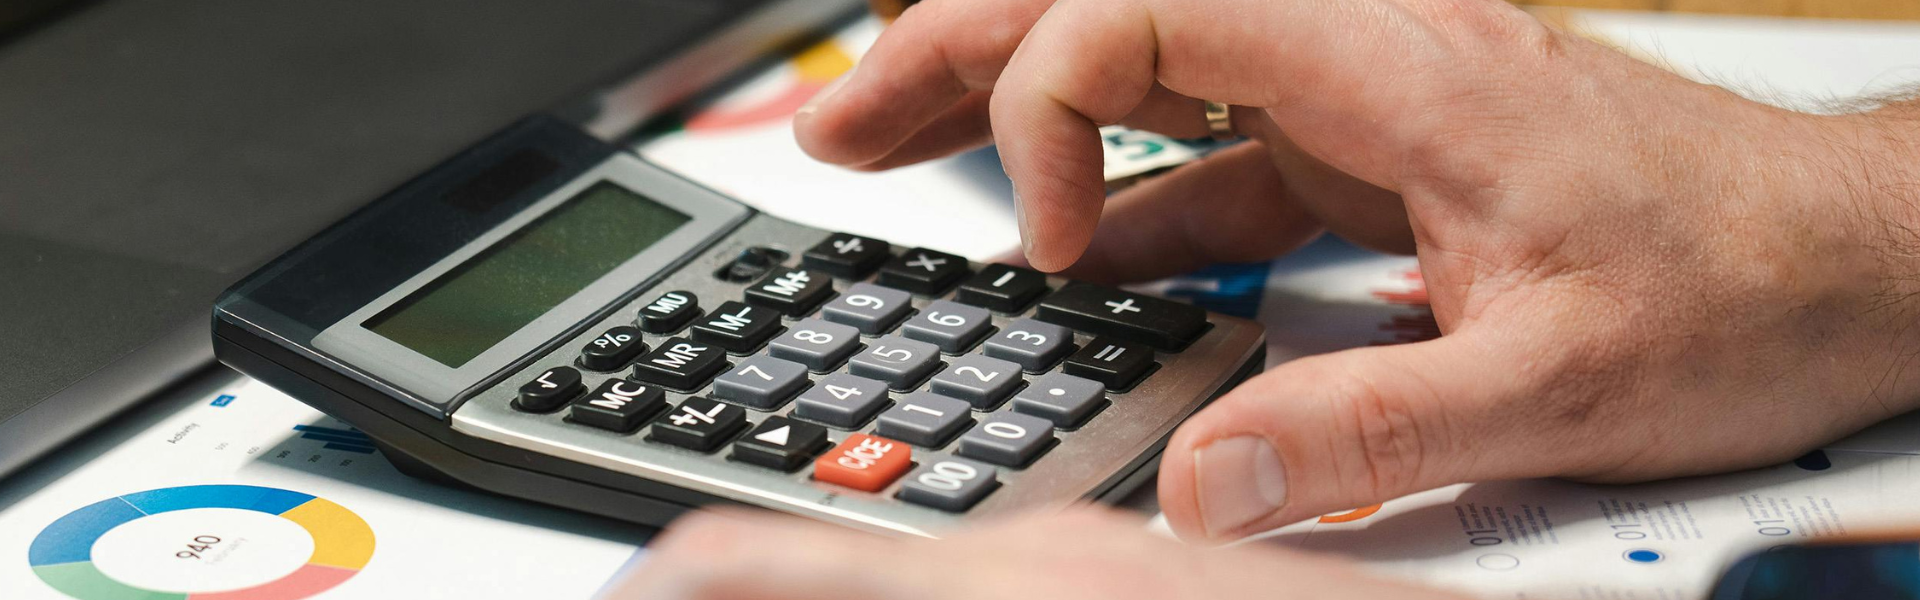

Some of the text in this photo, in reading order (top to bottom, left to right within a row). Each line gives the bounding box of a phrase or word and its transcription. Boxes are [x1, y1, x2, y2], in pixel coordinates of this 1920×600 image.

[763, 270, 810, 296] M+
[647, 293, 689, 314] MU
[845, 294, 884, 310] 9
[927, 311, 966, 328] 6
[793, 329, 833, 344] 8
[1006, 330, 1047, 346] 3
[651, 342, 707, 368] MR
[872, 345, 913, 362] 5
[737, 365, 774, 381] 7
[954, 366, 999, 382] 2
[589, 381, 646, 410] MC
[824, 383, 862, 400] 4
[902, 403, 945, 417] 1
[983, 421, 1027, 439] 0
[837, 438, 893, 470] C/CE
[918, 461, 977, 491] 00
[1610, 524, 1647, 540] 01
[1752, 520, 1791, 537] 01
[1466, 529, 1503, 546] 01
[175, 535, 221, 560] 940
